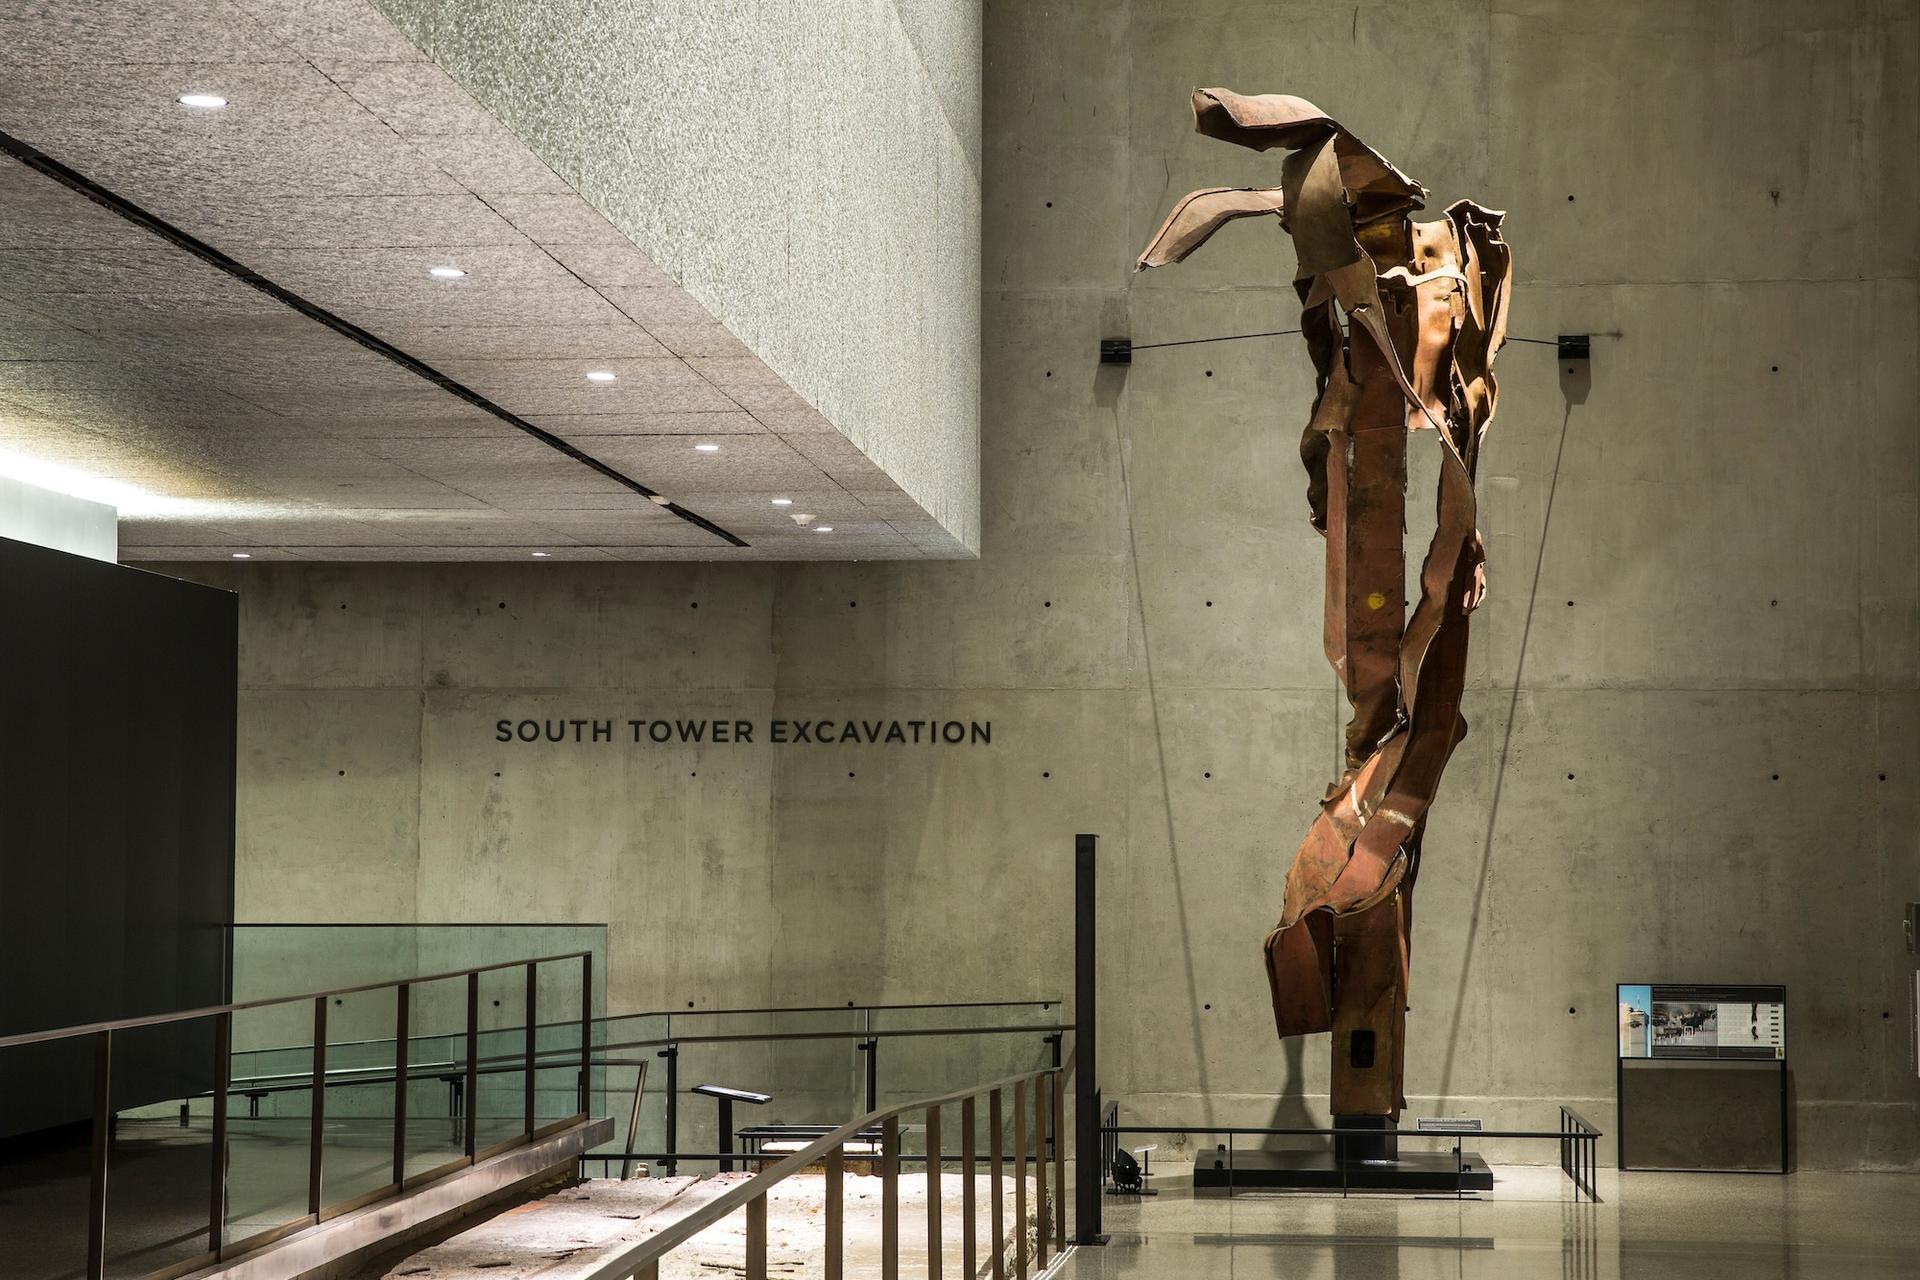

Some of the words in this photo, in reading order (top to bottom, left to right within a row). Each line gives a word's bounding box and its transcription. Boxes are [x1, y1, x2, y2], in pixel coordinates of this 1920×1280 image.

[495, 719, 612, 743] SOUTH
[628, 720, 754, 743] TOWER
[770, 720, 992, 744] EXCAVATION
